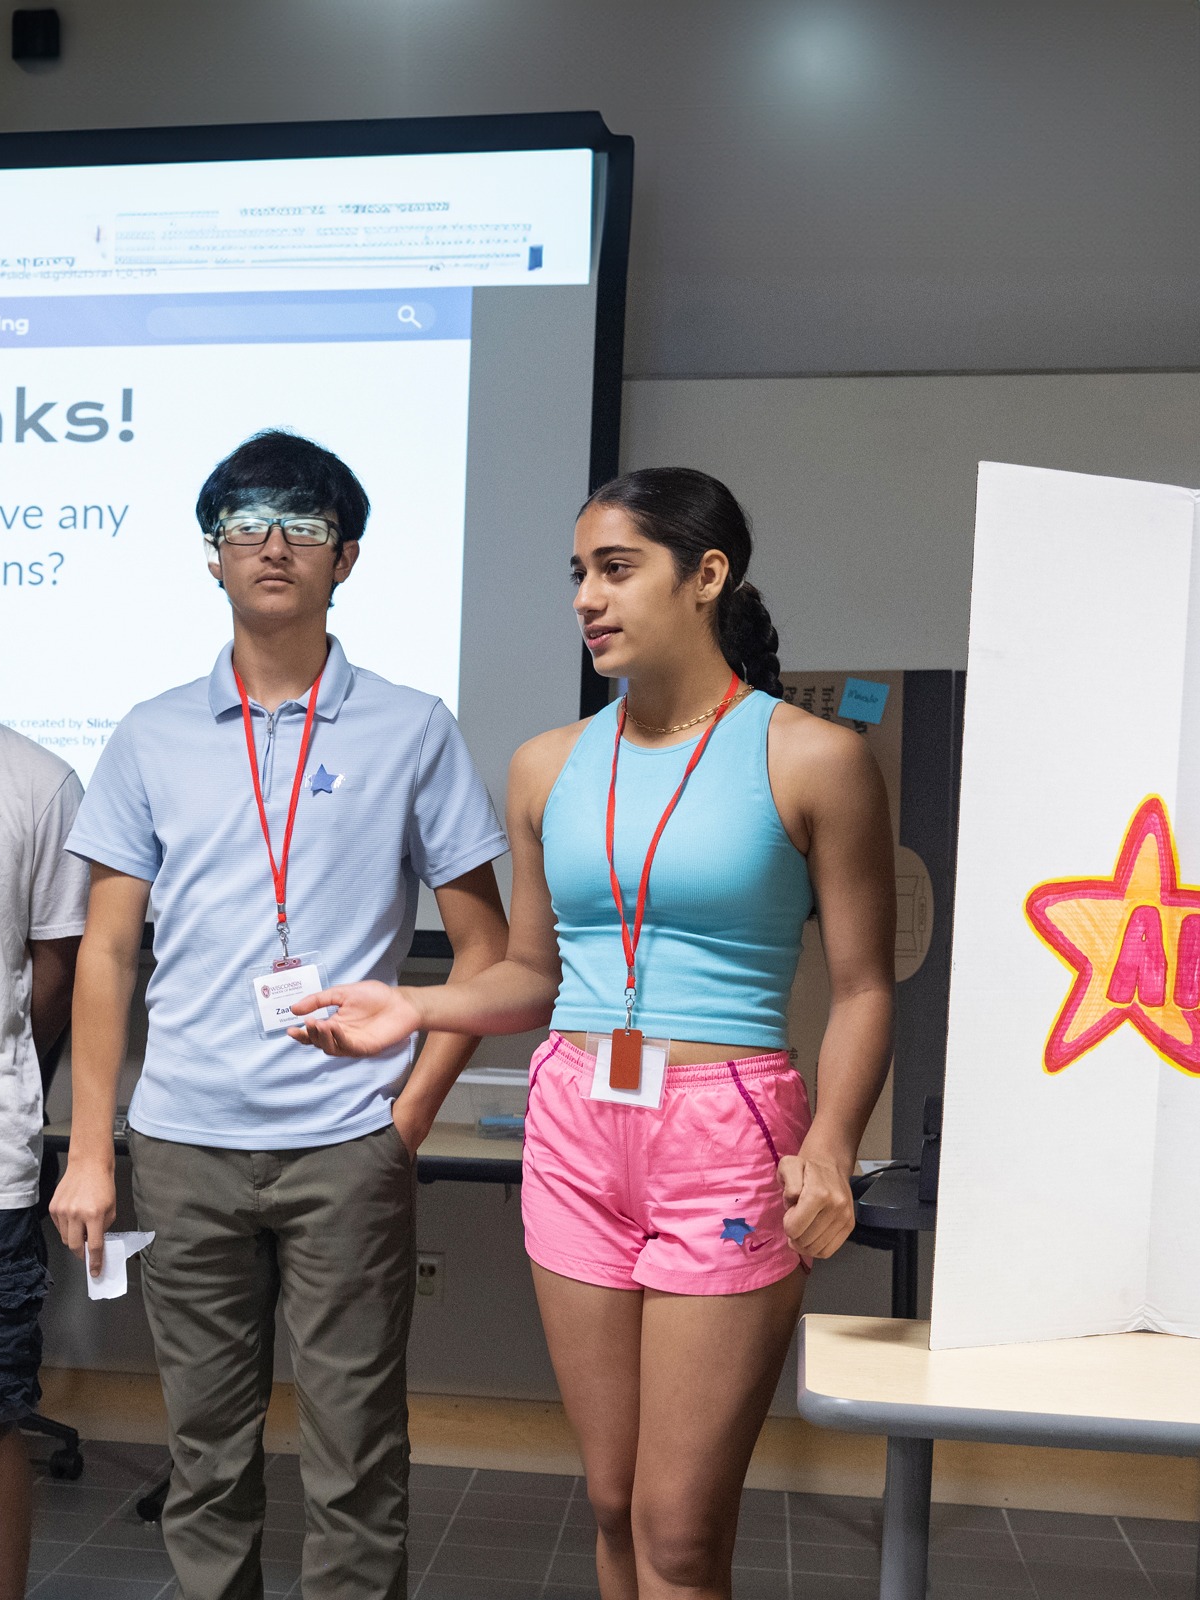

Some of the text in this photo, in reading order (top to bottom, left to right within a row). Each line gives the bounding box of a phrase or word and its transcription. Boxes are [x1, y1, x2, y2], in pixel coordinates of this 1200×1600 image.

[58, 503, 130, 538] any
[20, 717, 65, 729] created
[68, 717, 84, 730] by
[38, 735, 79, 748] images
[82, 735, 98, 747] by
